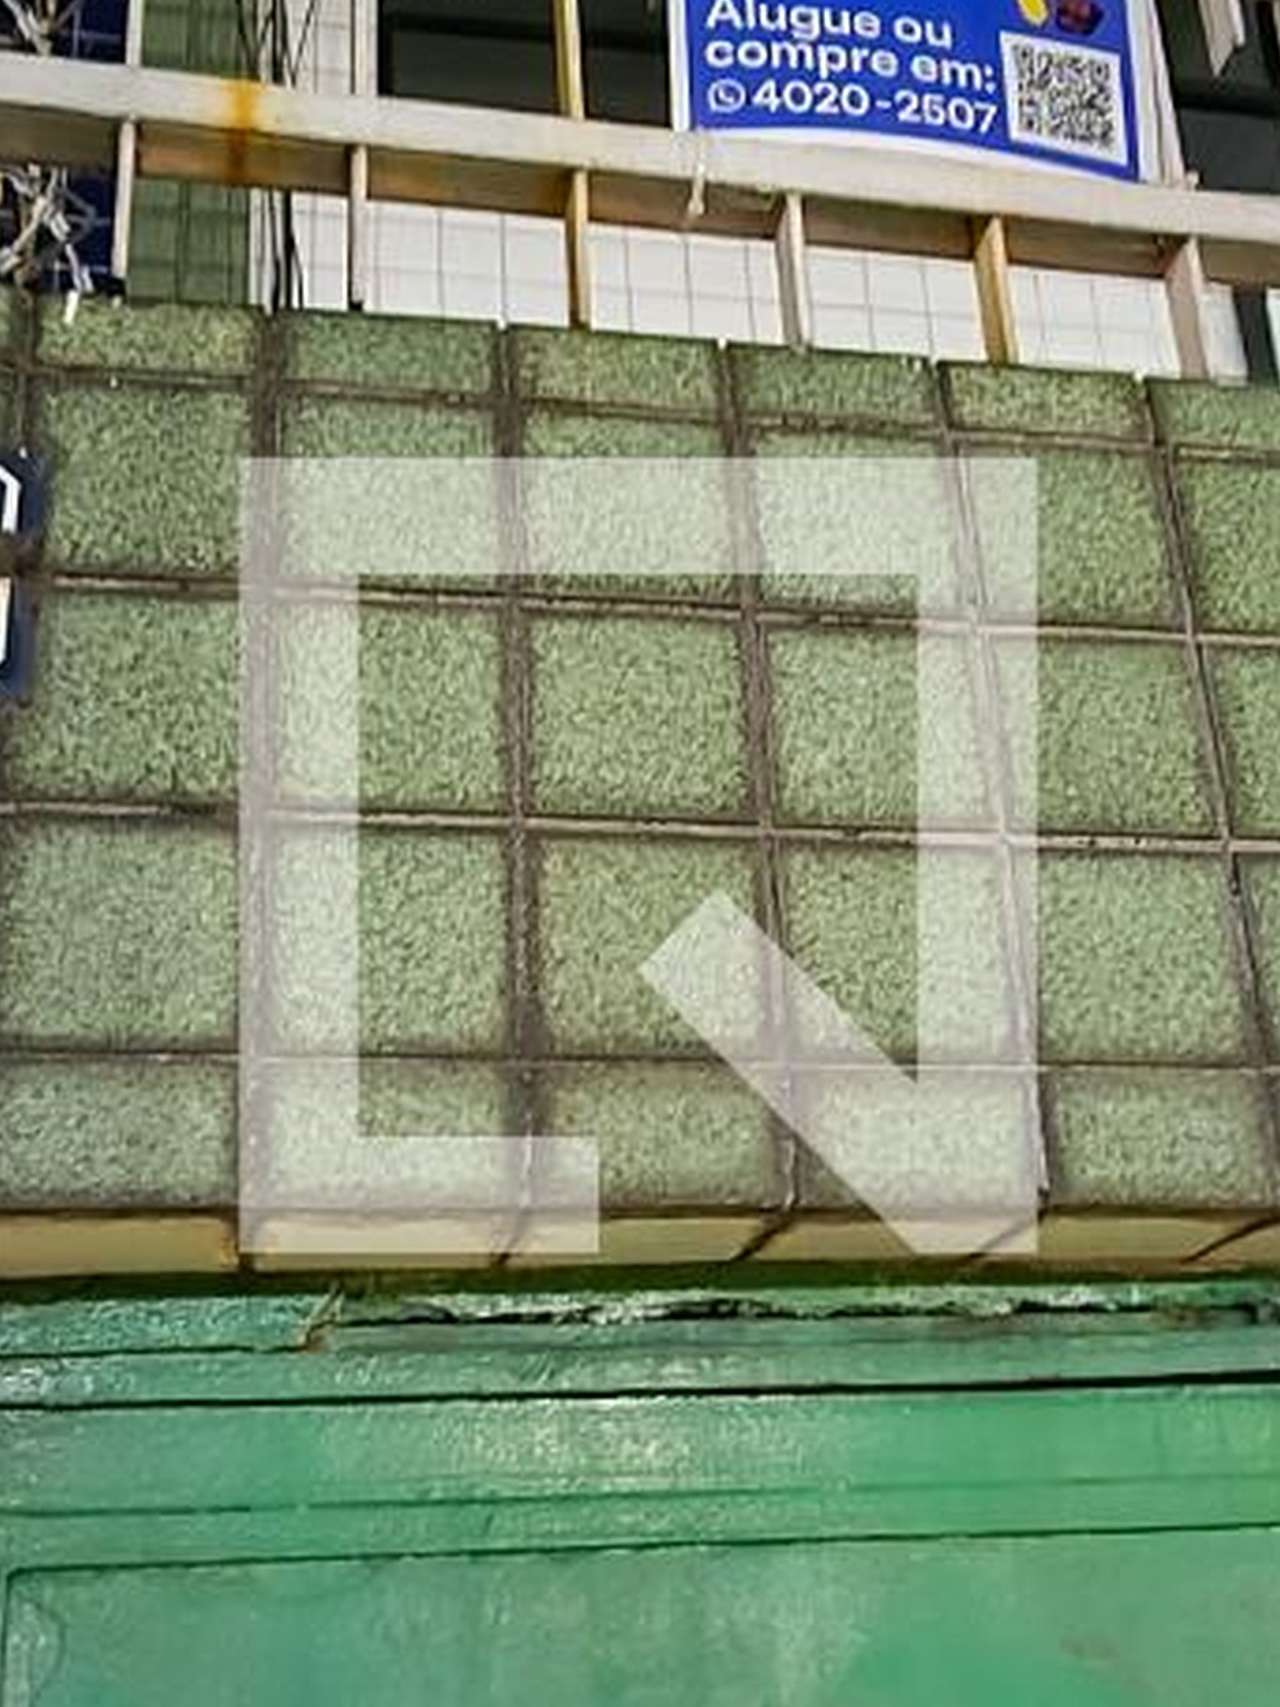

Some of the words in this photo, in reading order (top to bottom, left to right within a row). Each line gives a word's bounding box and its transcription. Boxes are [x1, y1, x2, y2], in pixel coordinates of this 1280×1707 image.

[892, 15, 954, 49] ou
[704, 39, 899, 80] compre
[910, 53, 998, 95] em:
